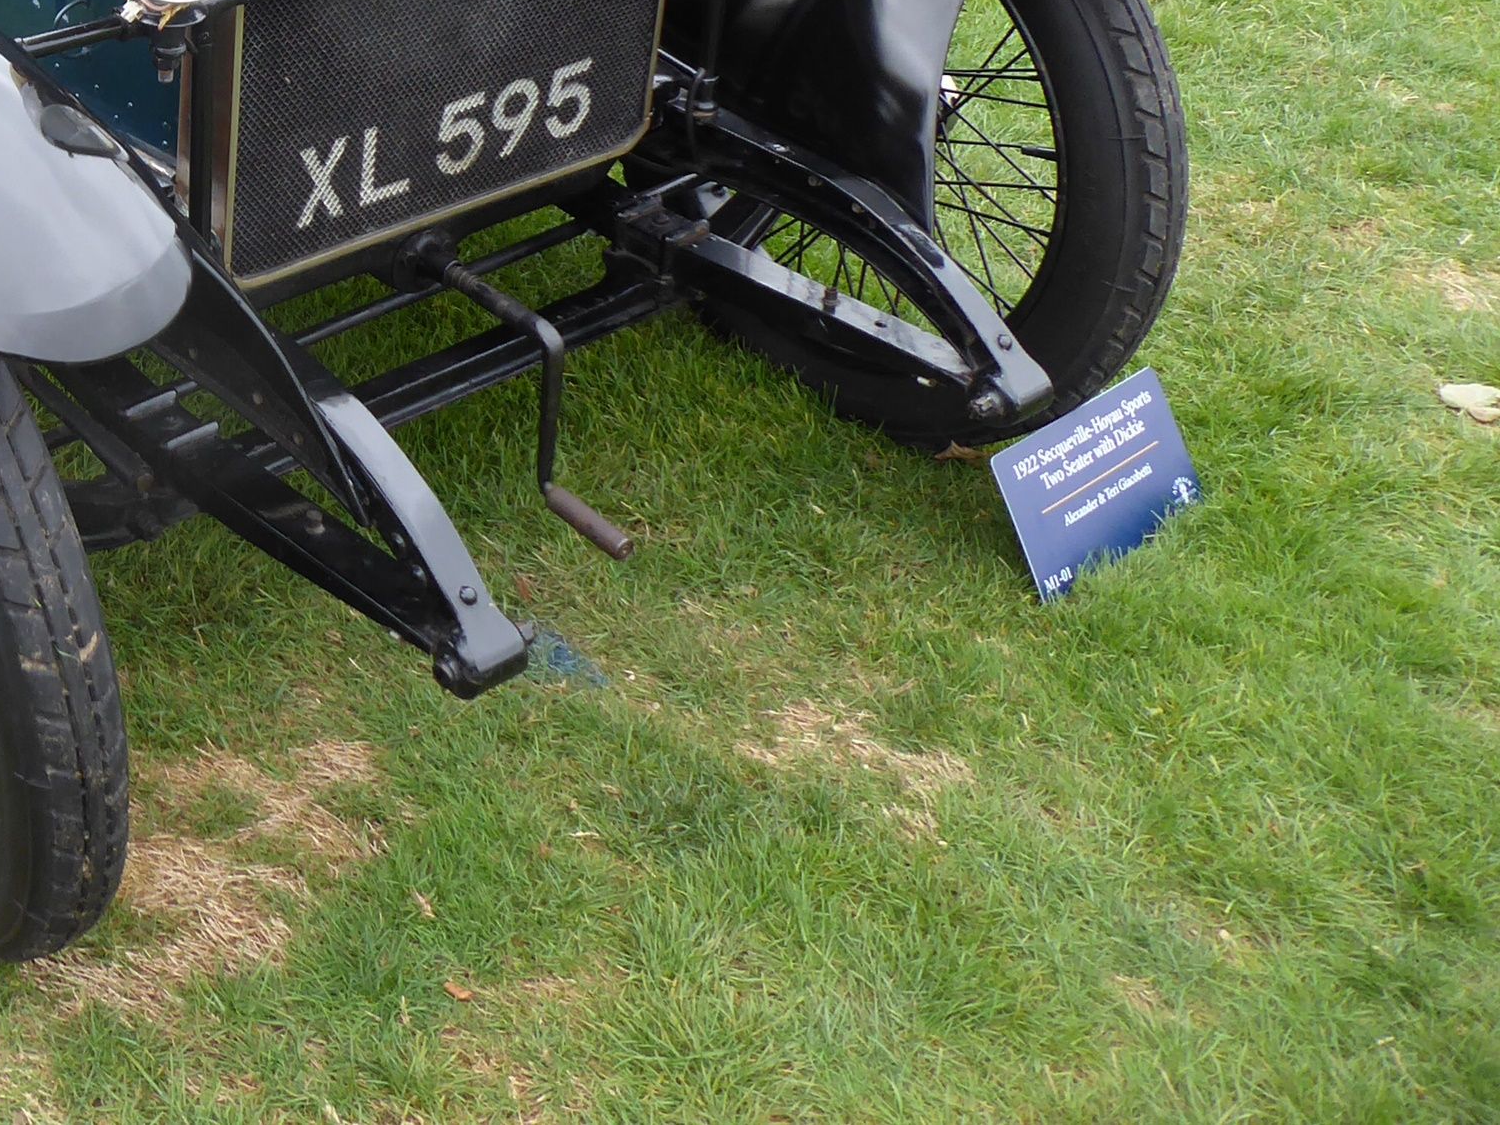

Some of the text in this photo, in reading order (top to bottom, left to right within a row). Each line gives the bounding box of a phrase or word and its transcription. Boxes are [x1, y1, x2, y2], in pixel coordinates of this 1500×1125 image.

[296, 57, 593, 229] XL 595
[1012, 390, 1152, 481] 1922 Secqueville-Hoyau Sports
[1040, 419, 1146, 490] Two Seater with Dickie
[1064, 496, 1099, 527] Alexander
[1097, 492, 1106, 505] &
[1104, 483, 1120, 500] Teri
[1044, 566, 1073, 593] M1-01
